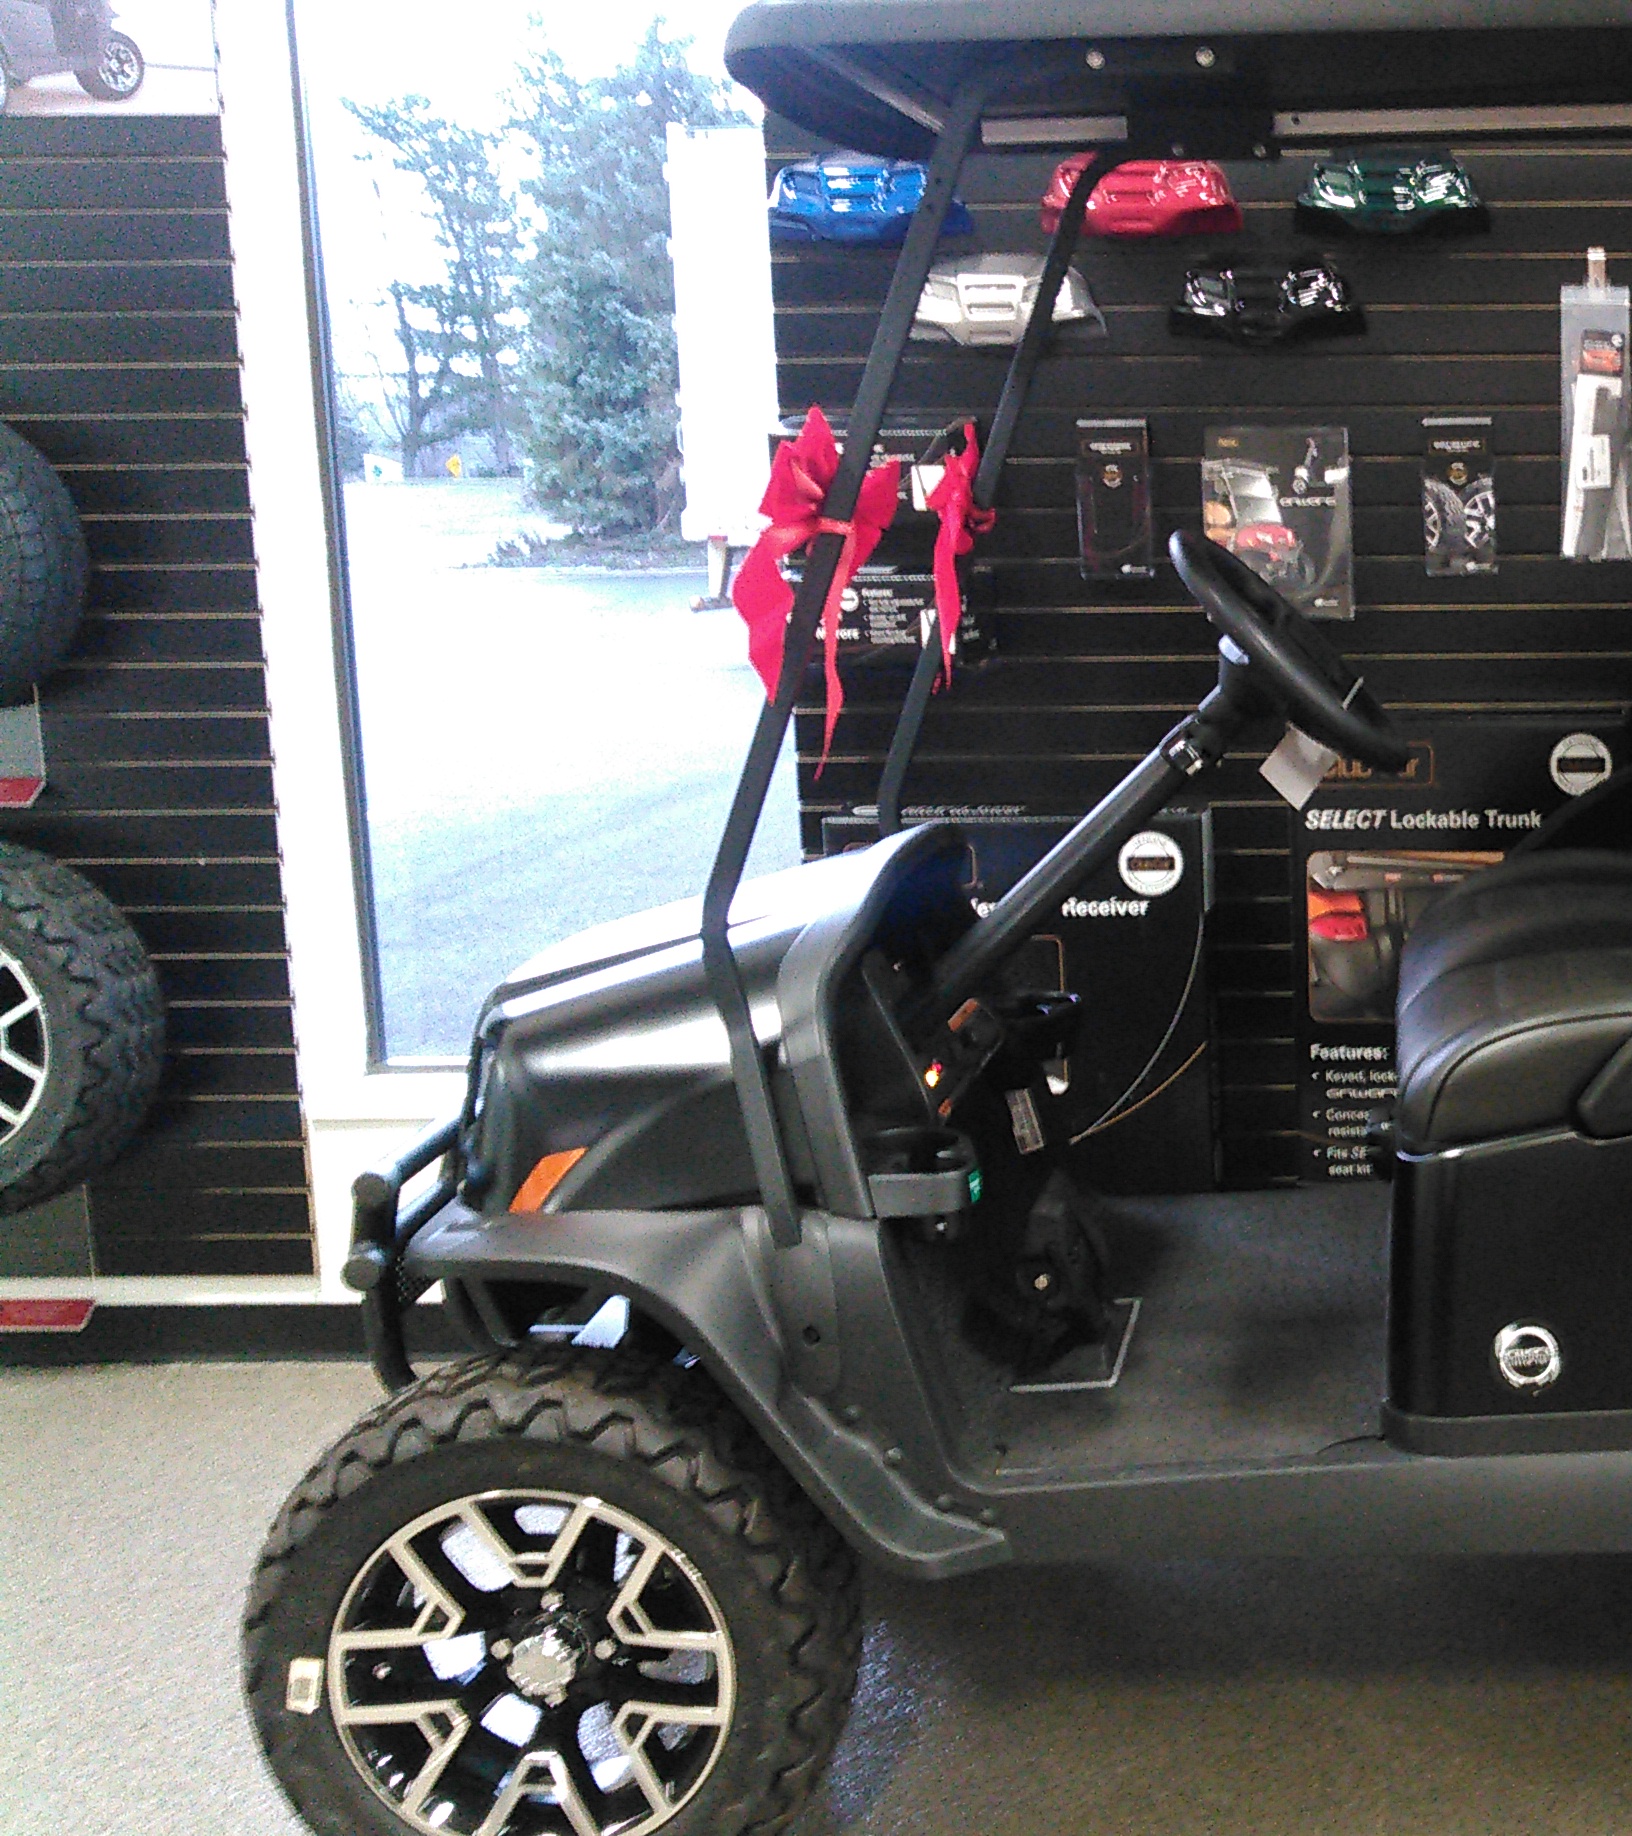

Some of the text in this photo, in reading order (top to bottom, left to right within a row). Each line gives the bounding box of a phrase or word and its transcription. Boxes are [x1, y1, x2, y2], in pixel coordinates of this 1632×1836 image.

[1305, 808, 1542, 830] SELECT Lockable Trunk
[1310, 1043, 1389, 1061] Features:
